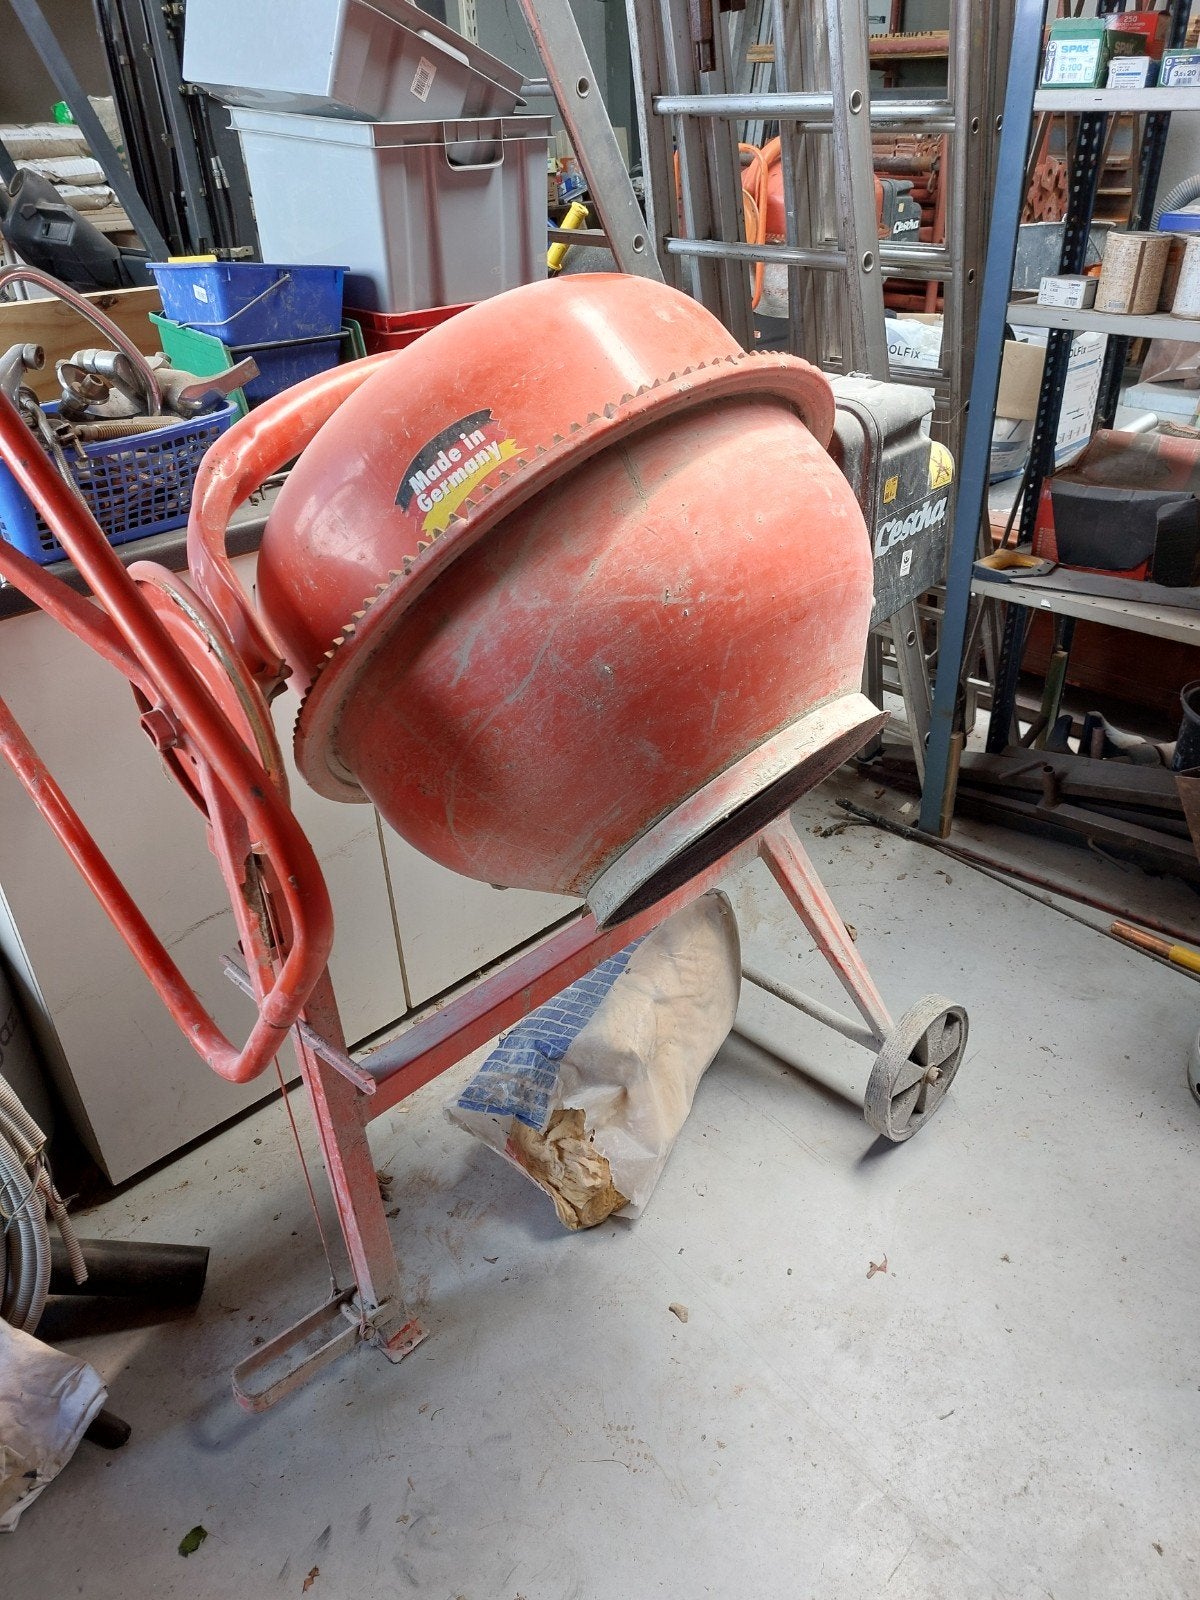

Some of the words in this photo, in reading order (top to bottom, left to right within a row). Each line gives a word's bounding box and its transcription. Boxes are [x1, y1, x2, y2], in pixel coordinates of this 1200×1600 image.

[1123, 15, 1138, 23] 250
[1061, 45, 1089, 53] SPAX
[887, 344, 920, 359] OLFix
[408, 448, 462, 496] Made
[460, 430, 487, 451] in
[417, 440, 502, 512] Germany
[874, 497, 948, 560] Lescha
